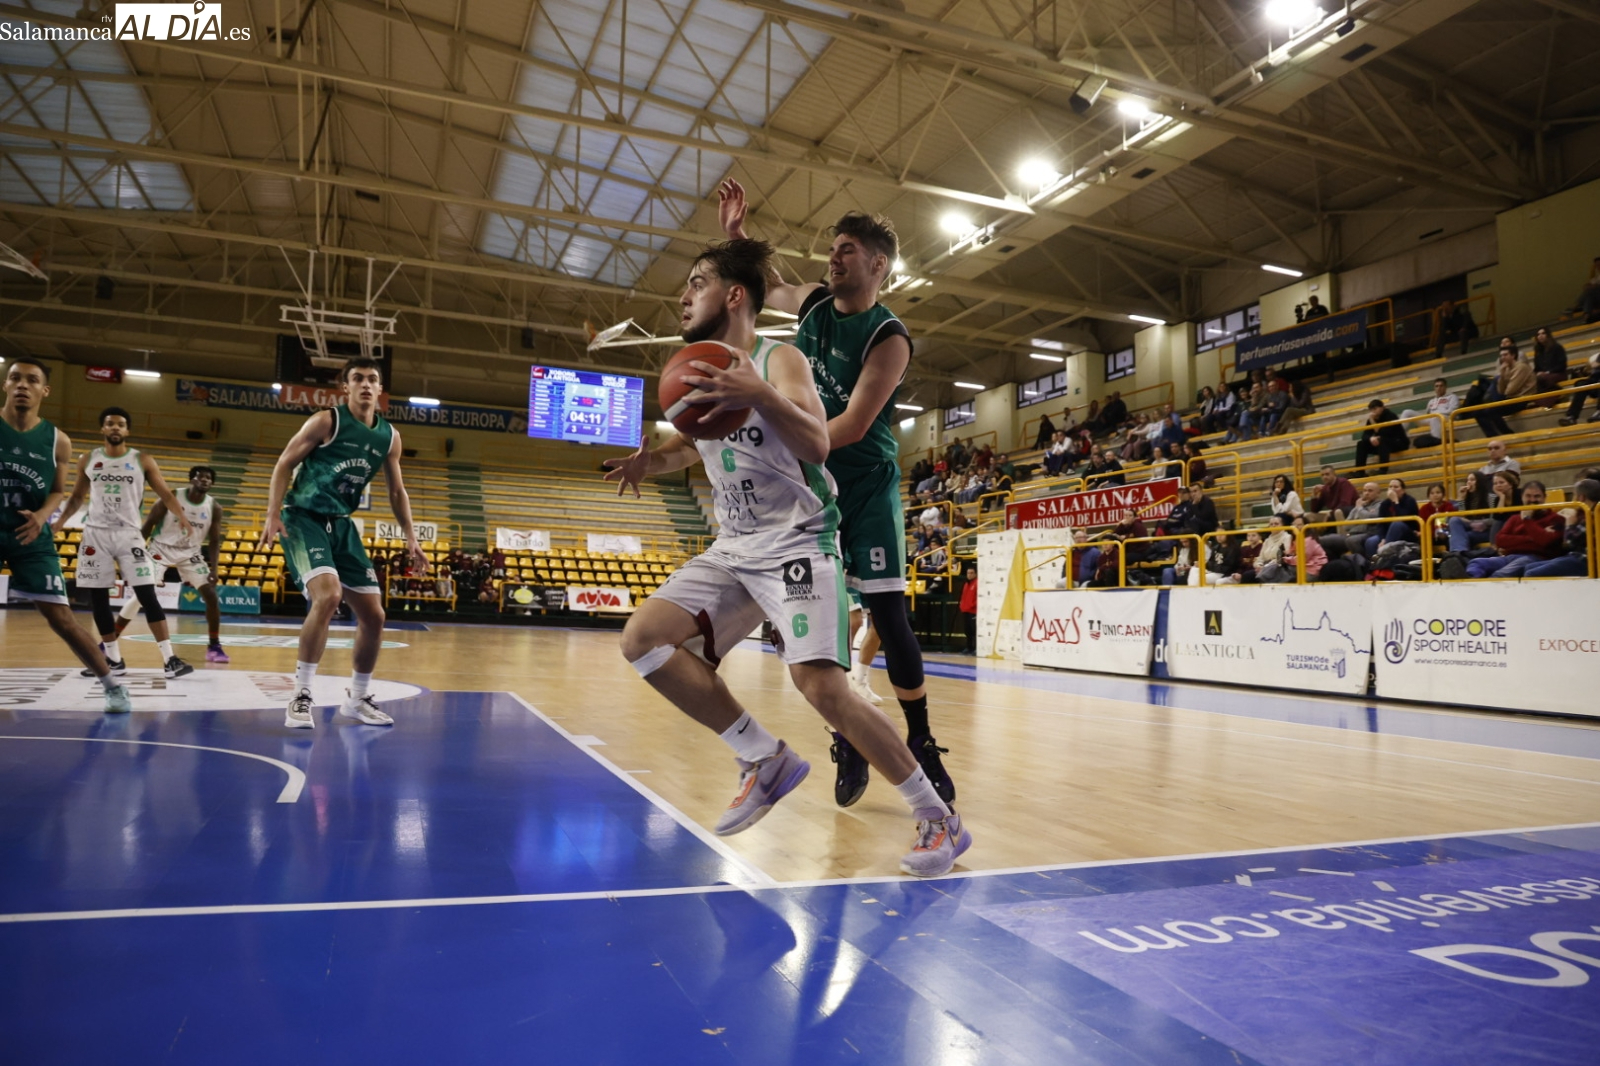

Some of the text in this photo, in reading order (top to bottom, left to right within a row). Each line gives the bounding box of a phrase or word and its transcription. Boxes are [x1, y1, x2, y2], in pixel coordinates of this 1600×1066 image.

[285, 385, 309, 404] LA
[429, 408, 449, 424] DE
[452, 409, 506, 430] EUROPA
[570, 411, 602, 424] 04:11
[721, 448, 737, 473] 6
[104, 484, 120, 494] 22
[1037, 486, 1155, 516] SALAMANCA
[1022, 514, 1076, 530] PATRIMONIO
[1077, 513, 1091, 525] DE
[1093, 512, 1107, 524] LA
[870, 546, 887, 571] 9
[135, 567, 151, 577] 22
[45, 574, 64, 591] 14
[225, 596, 257, 606] RURAL
[791, 613, 809, 639] 6
[1413, 618, 1507, 637] CORPORE
[1413, 639, 1508, 655] SPORT HEALTH
[1539, 638, 1600, 653] EXPOCE
[1286, 662, 1330, 672] SALAMANCA
[1414, 657, 1507, 669] www.corporesalamanca.es
